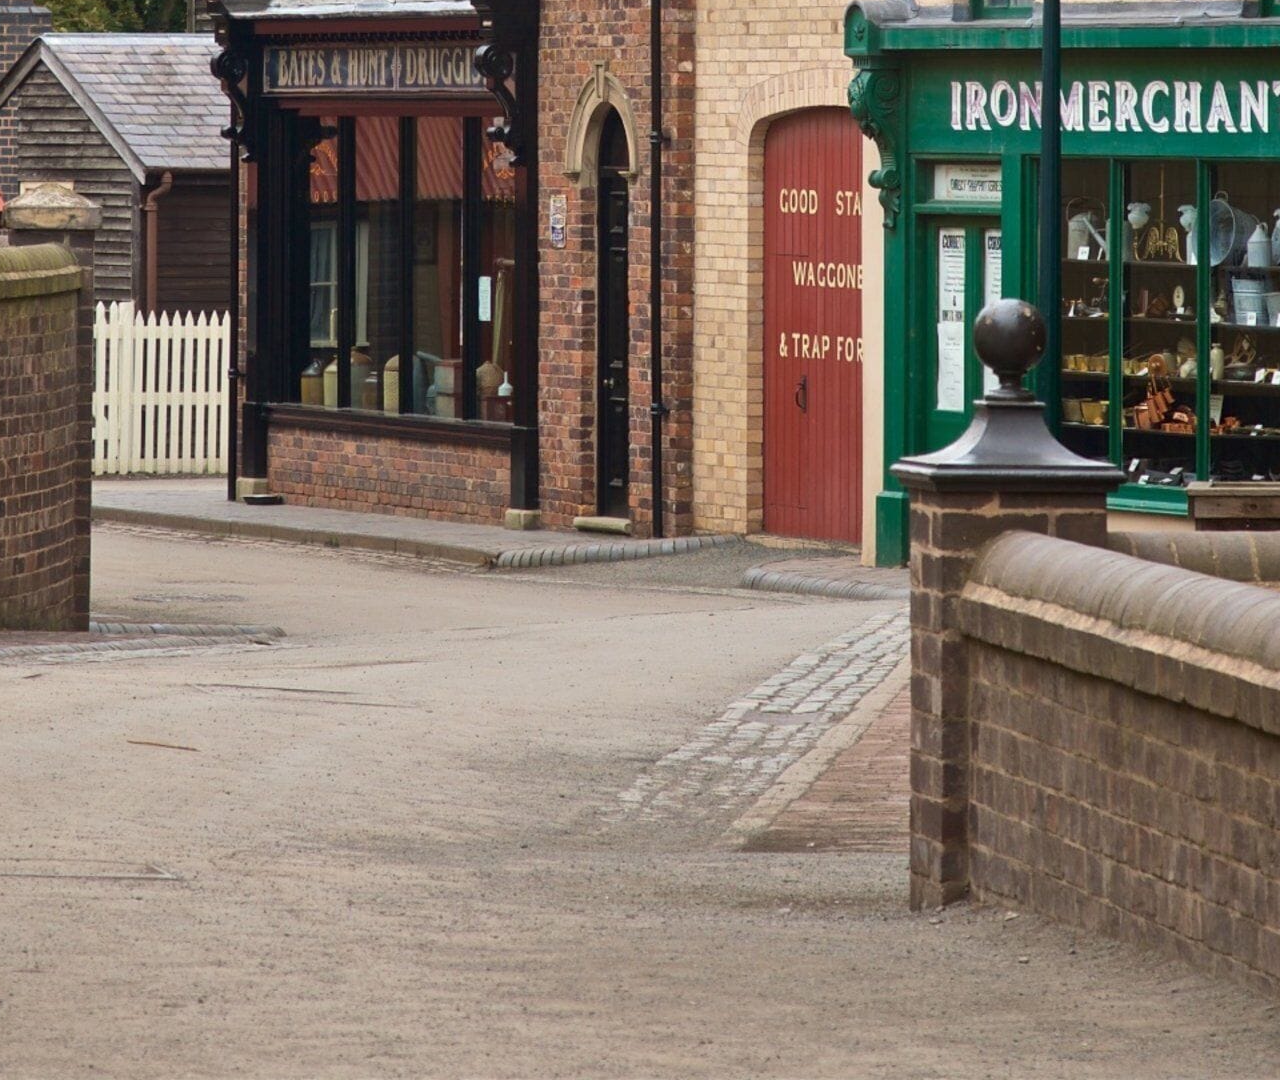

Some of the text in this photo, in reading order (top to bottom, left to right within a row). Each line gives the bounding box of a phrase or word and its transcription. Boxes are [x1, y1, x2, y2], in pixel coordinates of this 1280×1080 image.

[277, 49, 325, 87] BATES
[331, 50, 342, 86] &
[347, 48, 388, 87] HUNT
[779, 188, 819, 215] GOOD
[779, 332, 863, 363] & TRAP FOR
